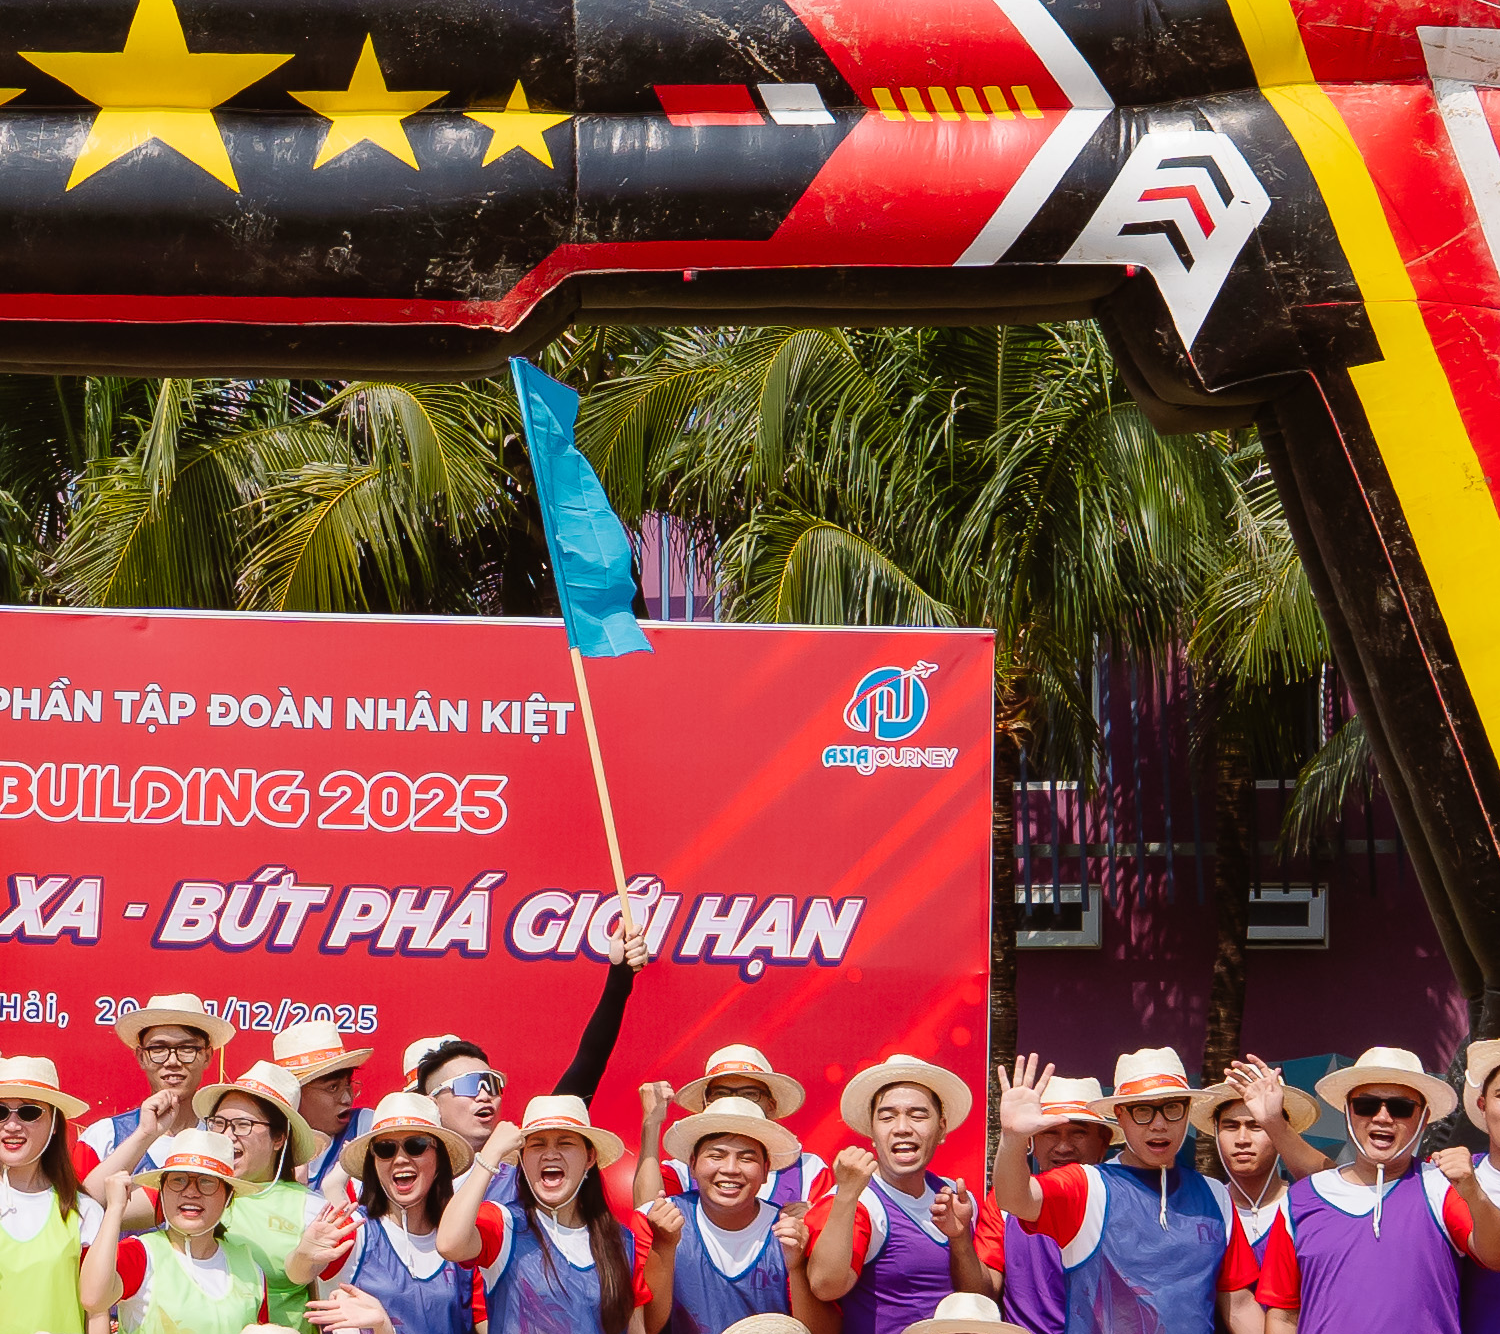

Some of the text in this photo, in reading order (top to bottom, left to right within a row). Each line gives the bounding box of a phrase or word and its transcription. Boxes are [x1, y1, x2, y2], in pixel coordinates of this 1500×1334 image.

[114, 683, 196, 734] TẬP
[206, 687, 333, 730] ĐOÀN
[345, 691, 468, 733] NHÂN
[481, 693, 575, 743] KIỆT
[318, 770, 508, 835] 2025
[324, 871, 506, 955] PHÁ
[673, 894, 866, 982] HẠN
[203, 997, 378, 1034] 1/12/2025
